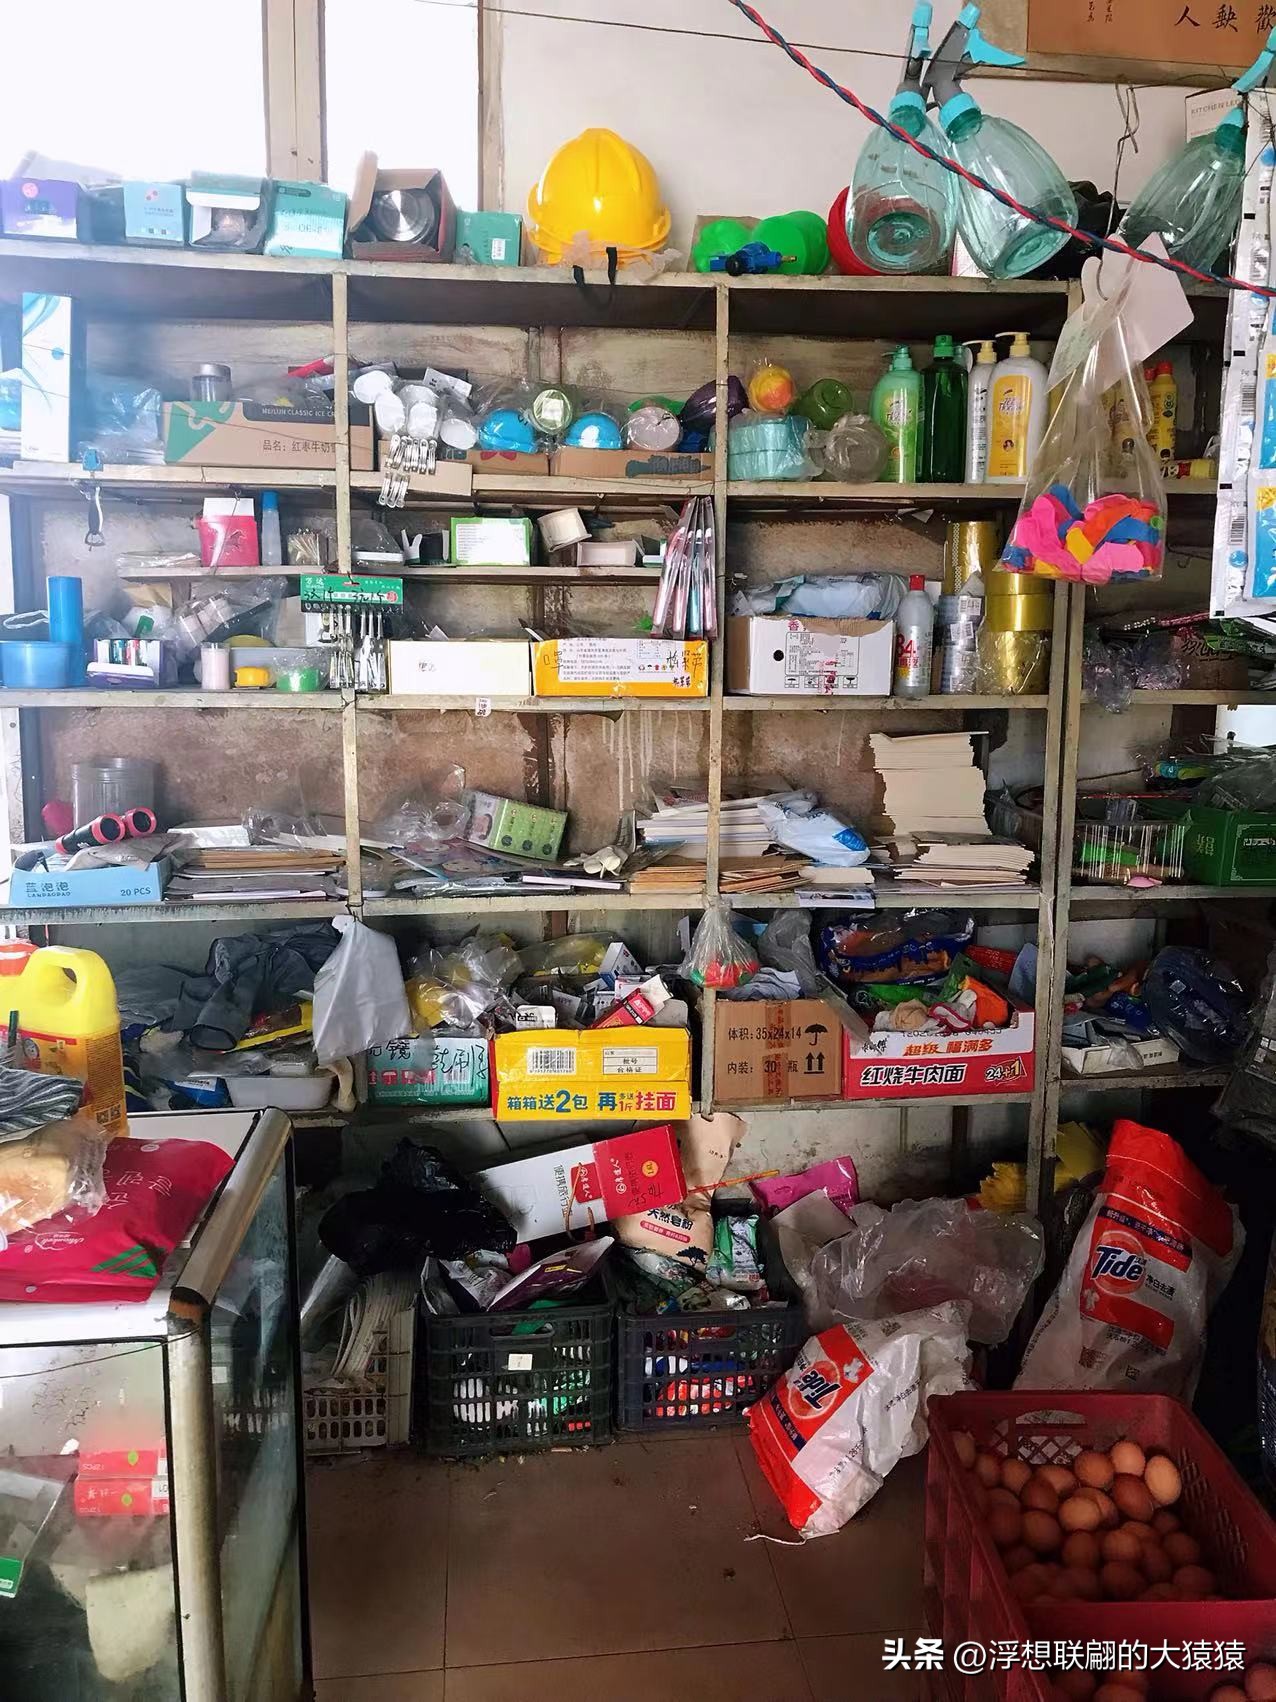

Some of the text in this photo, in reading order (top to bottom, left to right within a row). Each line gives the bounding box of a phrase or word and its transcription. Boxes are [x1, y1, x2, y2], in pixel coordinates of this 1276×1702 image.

[1174, 5, 1201, 27] 人
[287, 409, 313, 417] CLASSIC
[26, 881, 70, 893] 蓝泡泡
[121, 886, 151, 897] 20 PCS
[617, 1066, 643, 1074] 合格证
[764, 1060, 778, 1073] 30
[787, 1060, 800, 1073] 瓶
[860, 1063, 968, 1086] 红烧牛肉面
[507, 1090, 588, 1113] 箱箱送2包
[598, 1091, 617, 1112] 再
[636, 1091, 677, 1112] 挂面
[646, 1208, 694, 1230] 天然皂粉
[1090, 1244, 1143, 1282] Tide
[801, 1369, 842, 1411] Tide
